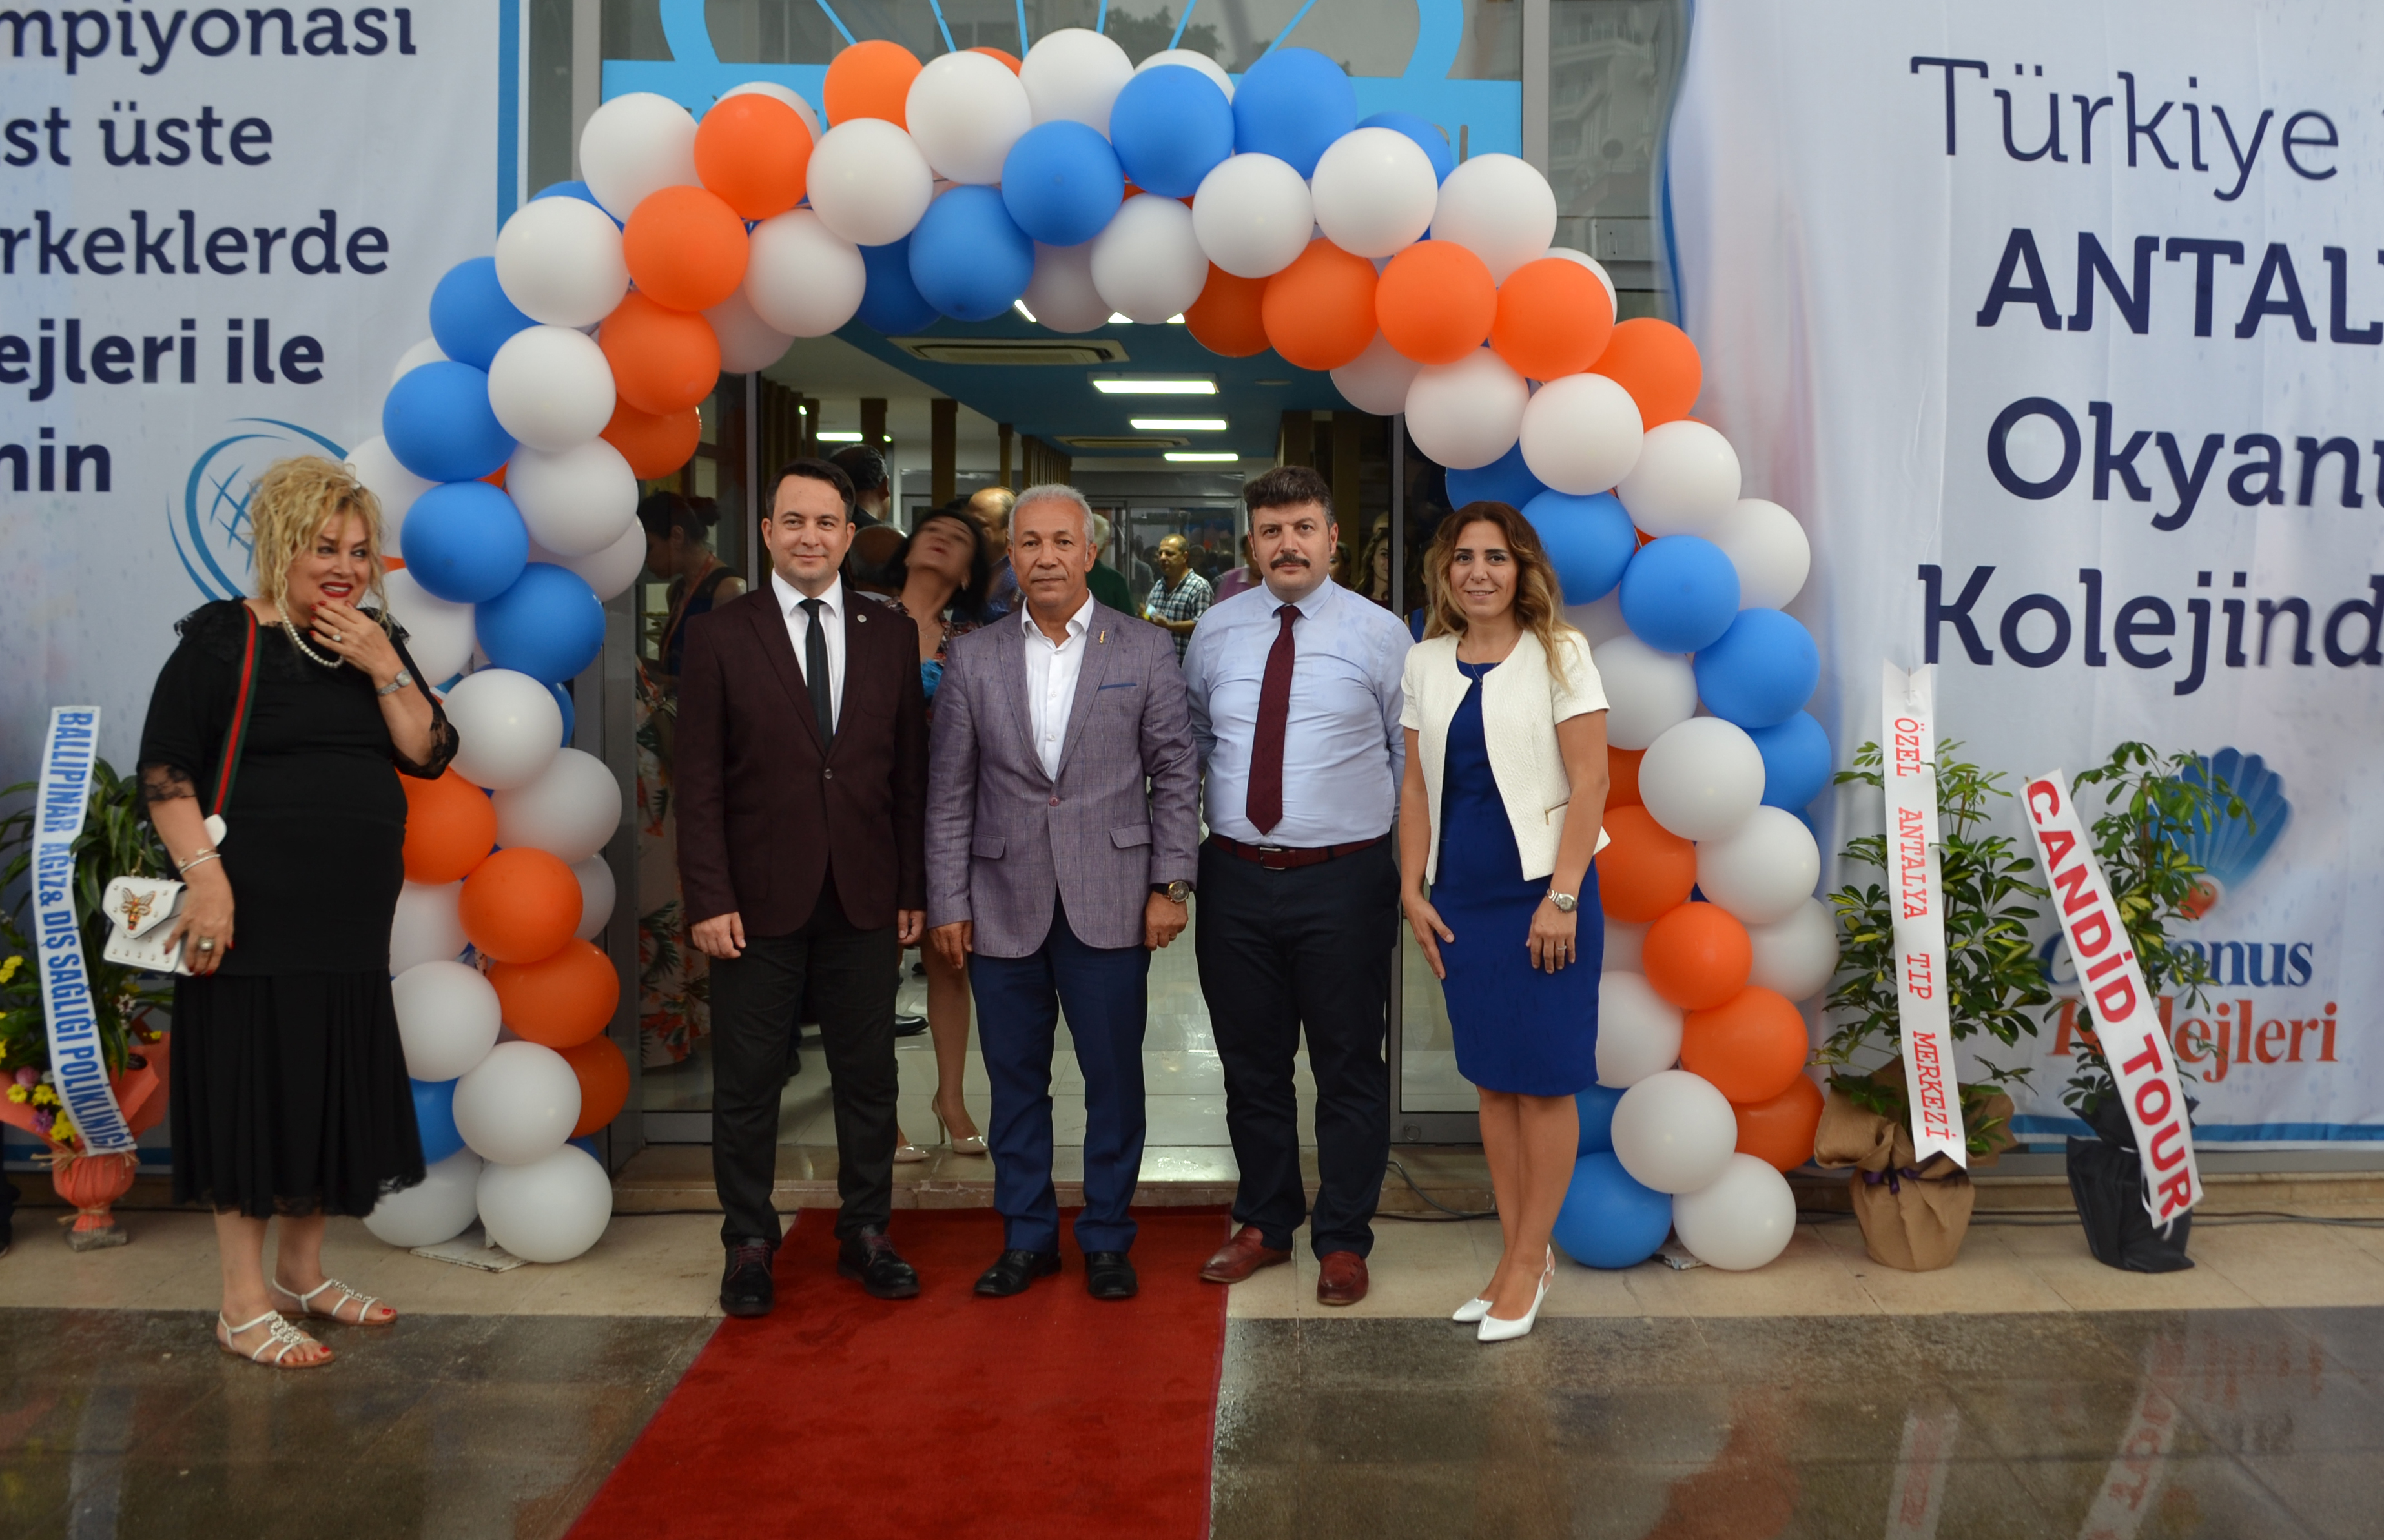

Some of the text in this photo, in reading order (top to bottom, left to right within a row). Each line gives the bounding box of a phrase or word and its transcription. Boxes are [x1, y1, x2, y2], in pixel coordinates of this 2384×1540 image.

[99, 101, 272, 167] üste
[1911, 56, 2339, 201] Türkiye
[227, 318, 324, 385] ile
[1976, 228, 2384, 345] ANTAL
[1987, 396, 2384, 531] Okyan
[1918, 564, 2384, 696] Kolejind
[1895, 717, 1957, 1140] ÖZEL ANTALYA TIP MERKEZİ
[2122, 1032, 2193, 1220] TOUR
